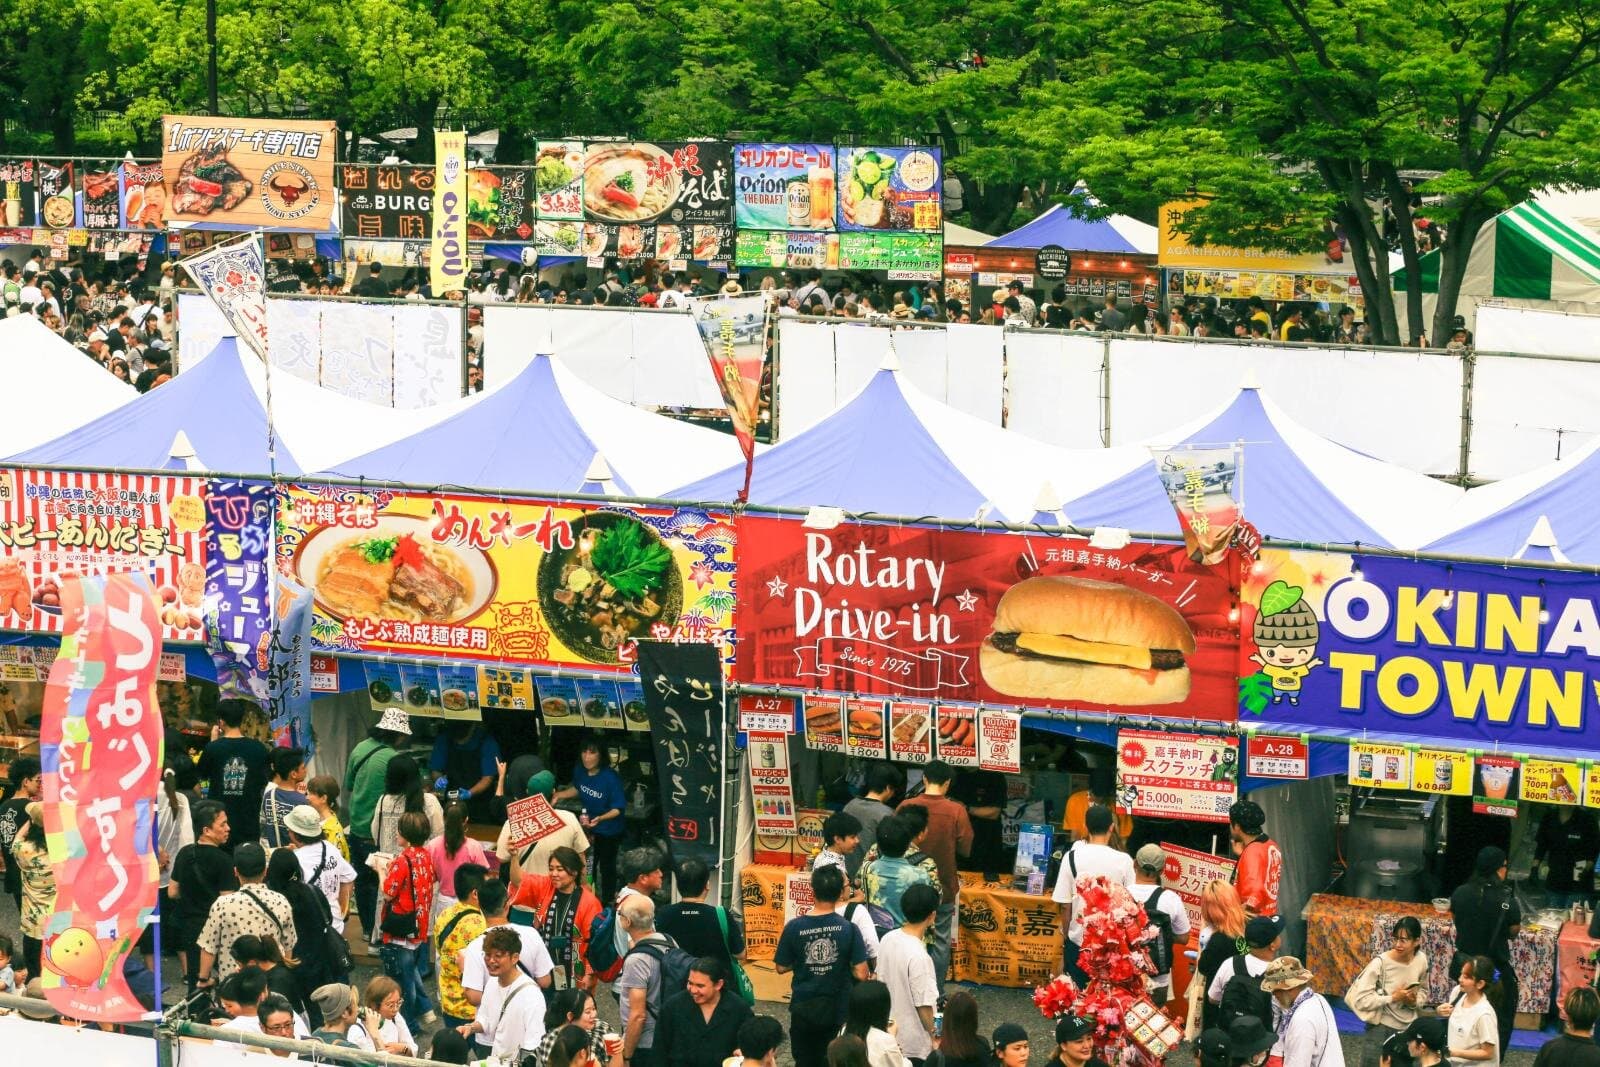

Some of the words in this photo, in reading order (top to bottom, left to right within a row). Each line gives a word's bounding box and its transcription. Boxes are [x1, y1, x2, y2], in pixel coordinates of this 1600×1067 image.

[646, 144, 703, 187] 沖縄
[740, 149, 830, 169] オリオンビール
[678, 169, 730, 209] そば
[739, 173, 787, 193] Orion
[375, 196, 433, 210] BURG
[744, 194, 759, 204] THE
[787, 232, 827, 243] オリオンビール
[787, 243, 814, 254] Orion
[295, 500, 379, 528] 沖縄そば
[804, 533, 946, 603] Rotary
[1045, 547, 1175, 587] 元祖嘉手納バーガー
[795, 588, 961, 646] Drive-in
[344, 619, 488, 649] もとぶ熟成麺使用
[652, 622, 726, 648] やんばる
[311, 659, 327, 671] -26
[839, 646, 876, 669] Since
[880, 655, 917, 677] 1975
[1330, 651, 1584, 728] TOWN
[755, 699, 782, 711] A-27
[984, 717, 1015, 728] ROTARY
[985, 728, 1016, 739] DRIVE-IN
[1154, 746, 1204, 760] 嘉手納町
[1264, 743, 1294, 755] A-28
[1354, 745, 1406, 756] オリオンWATTA
[1417, 752, 1467, 763] オリオンビール
[753, 769, 787, 777] オリオンビール
[1143, 759, 1213, 778] スクラッチ
[1125, 775, 1232, 792] 簡単なアンケートに答えて参加
[1526, 779, 1549, 790] 700円
[1146, 791, 1184, 804] 5,000円
[1525, 792, 1549, 801] 800円
[509, 810, 561, 842] 最後尾
[1189, 864, 1227, 881] 嘉手納町
[792, 881, 812, 890] ROTA
[771, 882, 785, 912] 沖縄県
[1004, 907, 1018, 936] 沖縄県
[1022, 904, 1059, 936] 嘉
